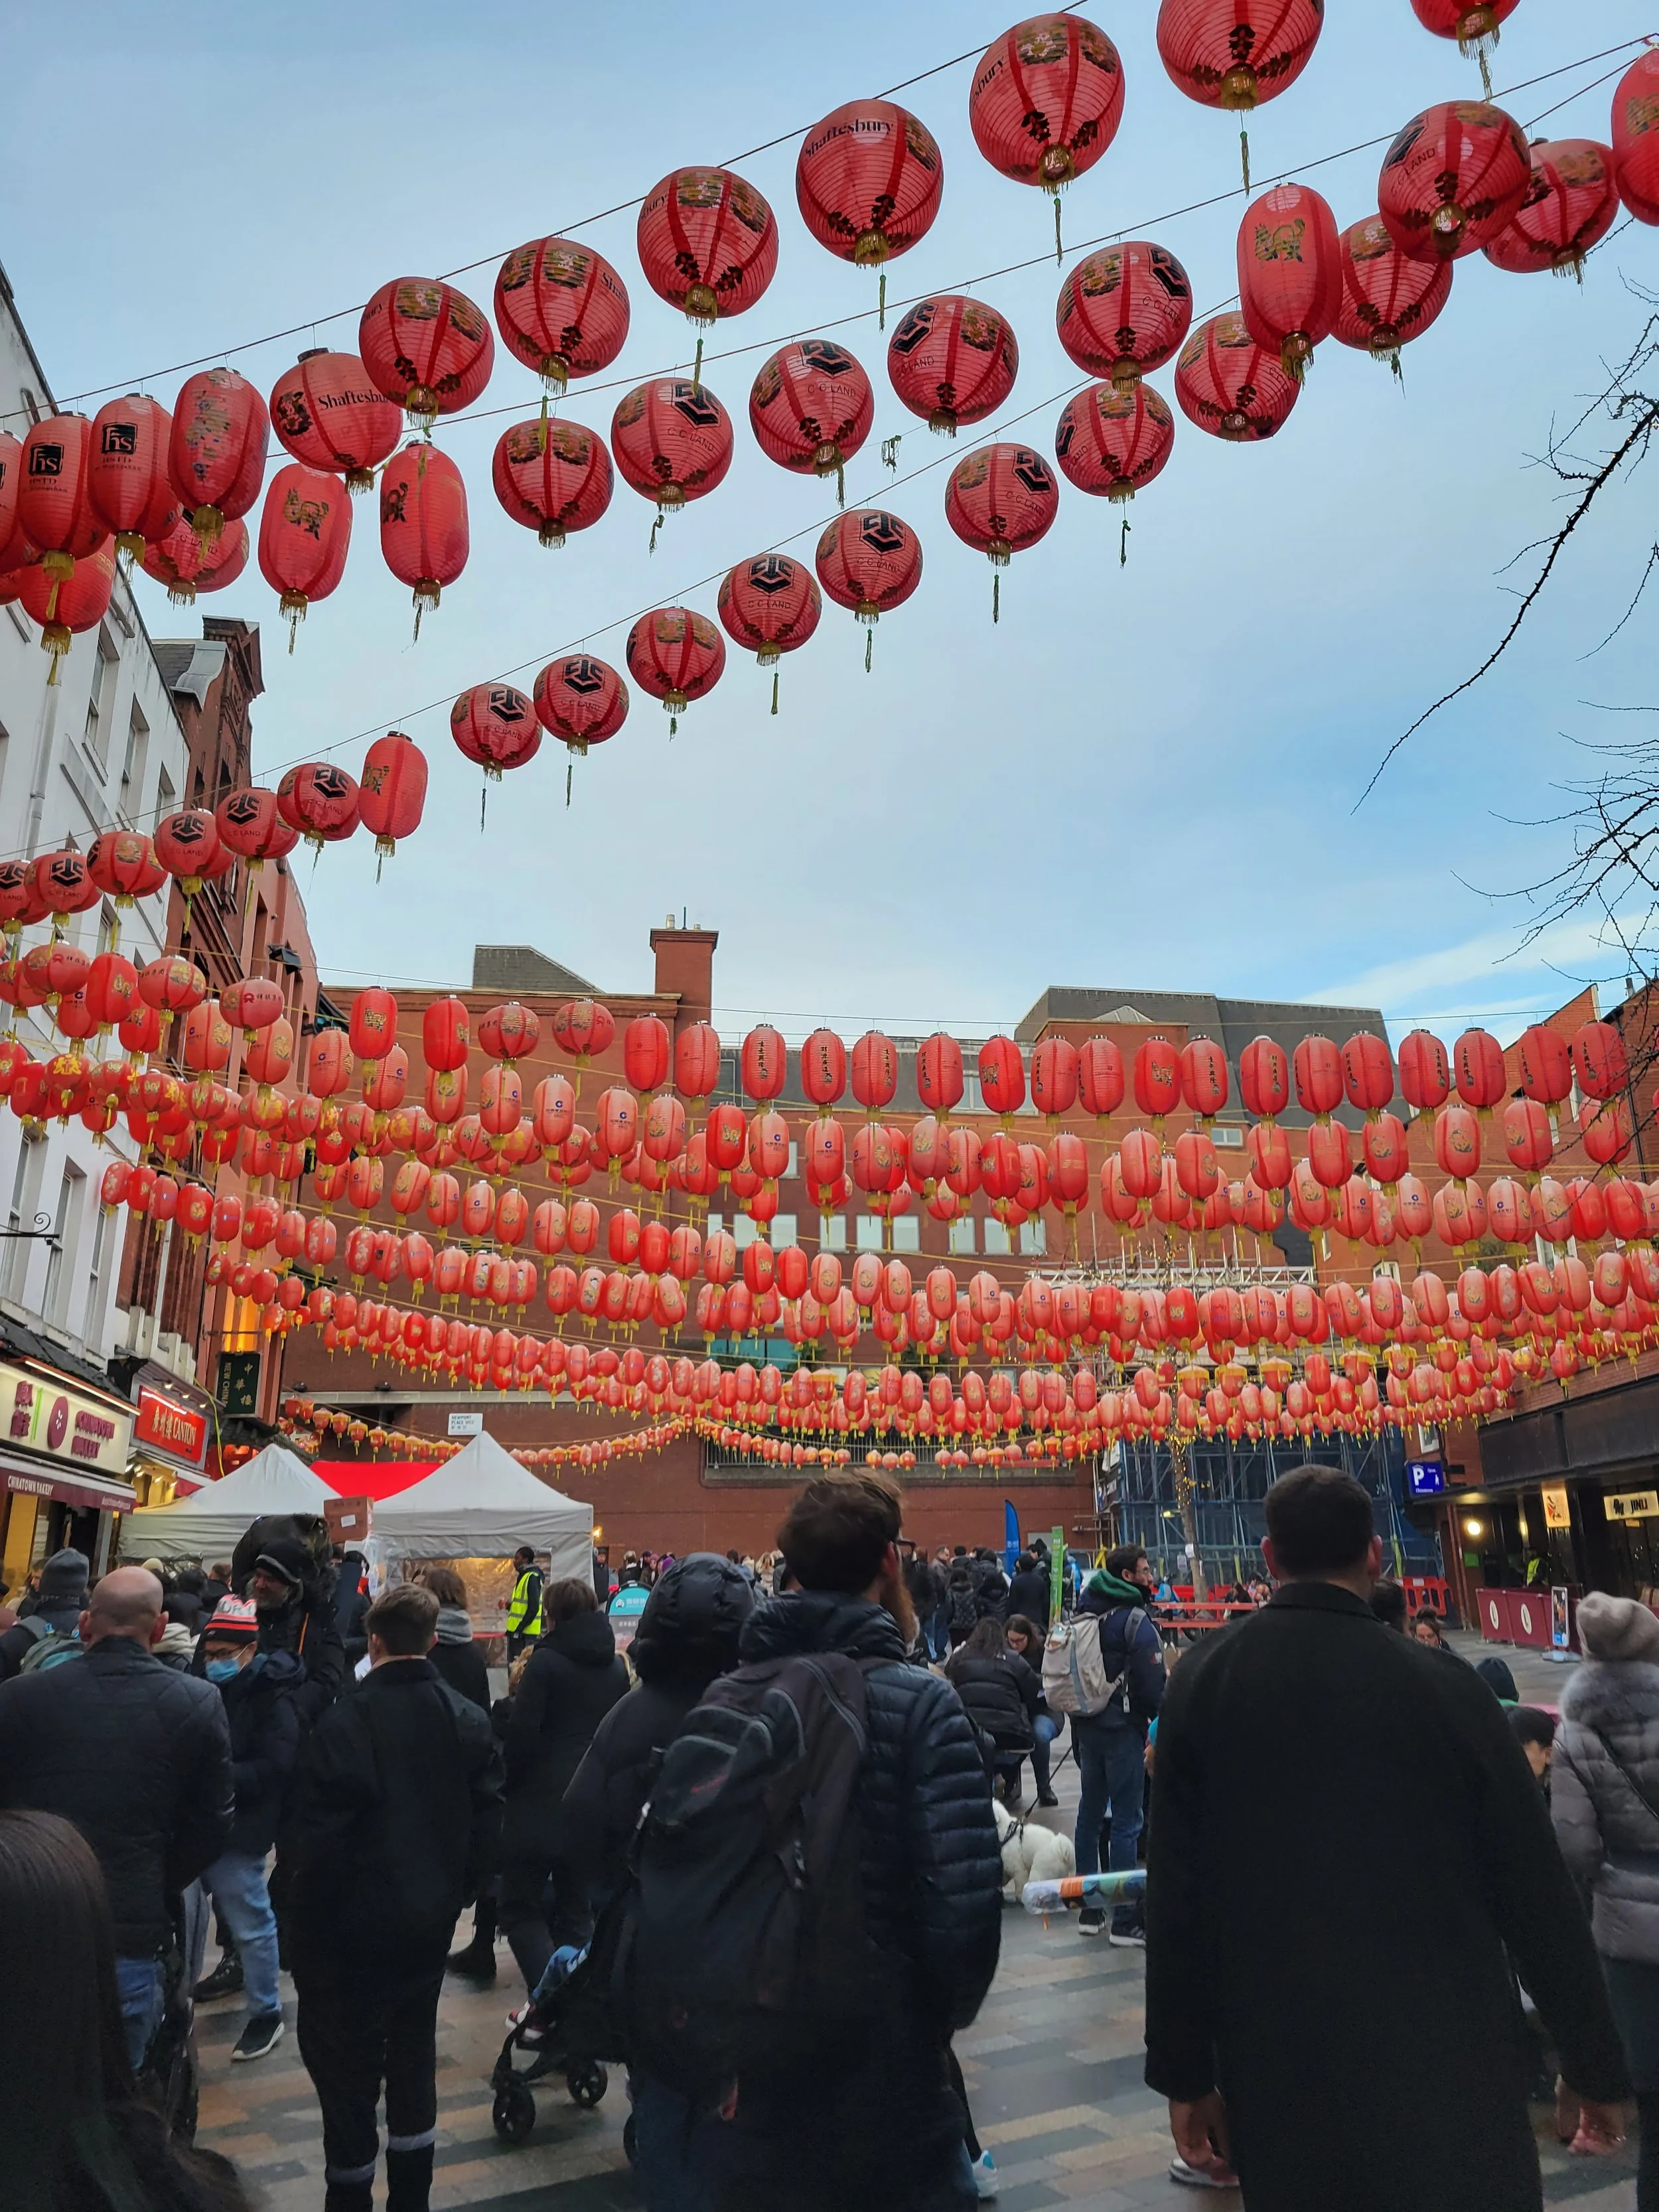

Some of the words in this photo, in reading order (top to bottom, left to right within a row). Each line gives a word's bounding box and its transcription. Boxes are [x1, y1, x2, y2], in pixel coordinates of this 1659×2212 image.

[804, 118, 894, 157] Shaftesbury
[1405, 146, 1437, 181] LAND
[1142, 295, 1151, 307] C
[1153, 300, 1162, 311] C
[317, 390, 388, 411] Shaftesbu
[831, 385, 857, 398] LAND
[668, 427, 676, 436] C
[679, 429, 687, 439] C
[689, 434, 715, 452] LAND
[1025, 500, 1045, 516] LAND
[876, 559, 901, 573] LAND
[323, 802, 342, 815] LAND
[173, 1416, 197, 1445] CANTON
[8, 1475, 36, 1493] CHINATOWN
[36, 1482, 54, 1497] BAKERY
[1413, 1467, 1425, 1486] P
[1630, 1498, 1648, 1514] JINLI
